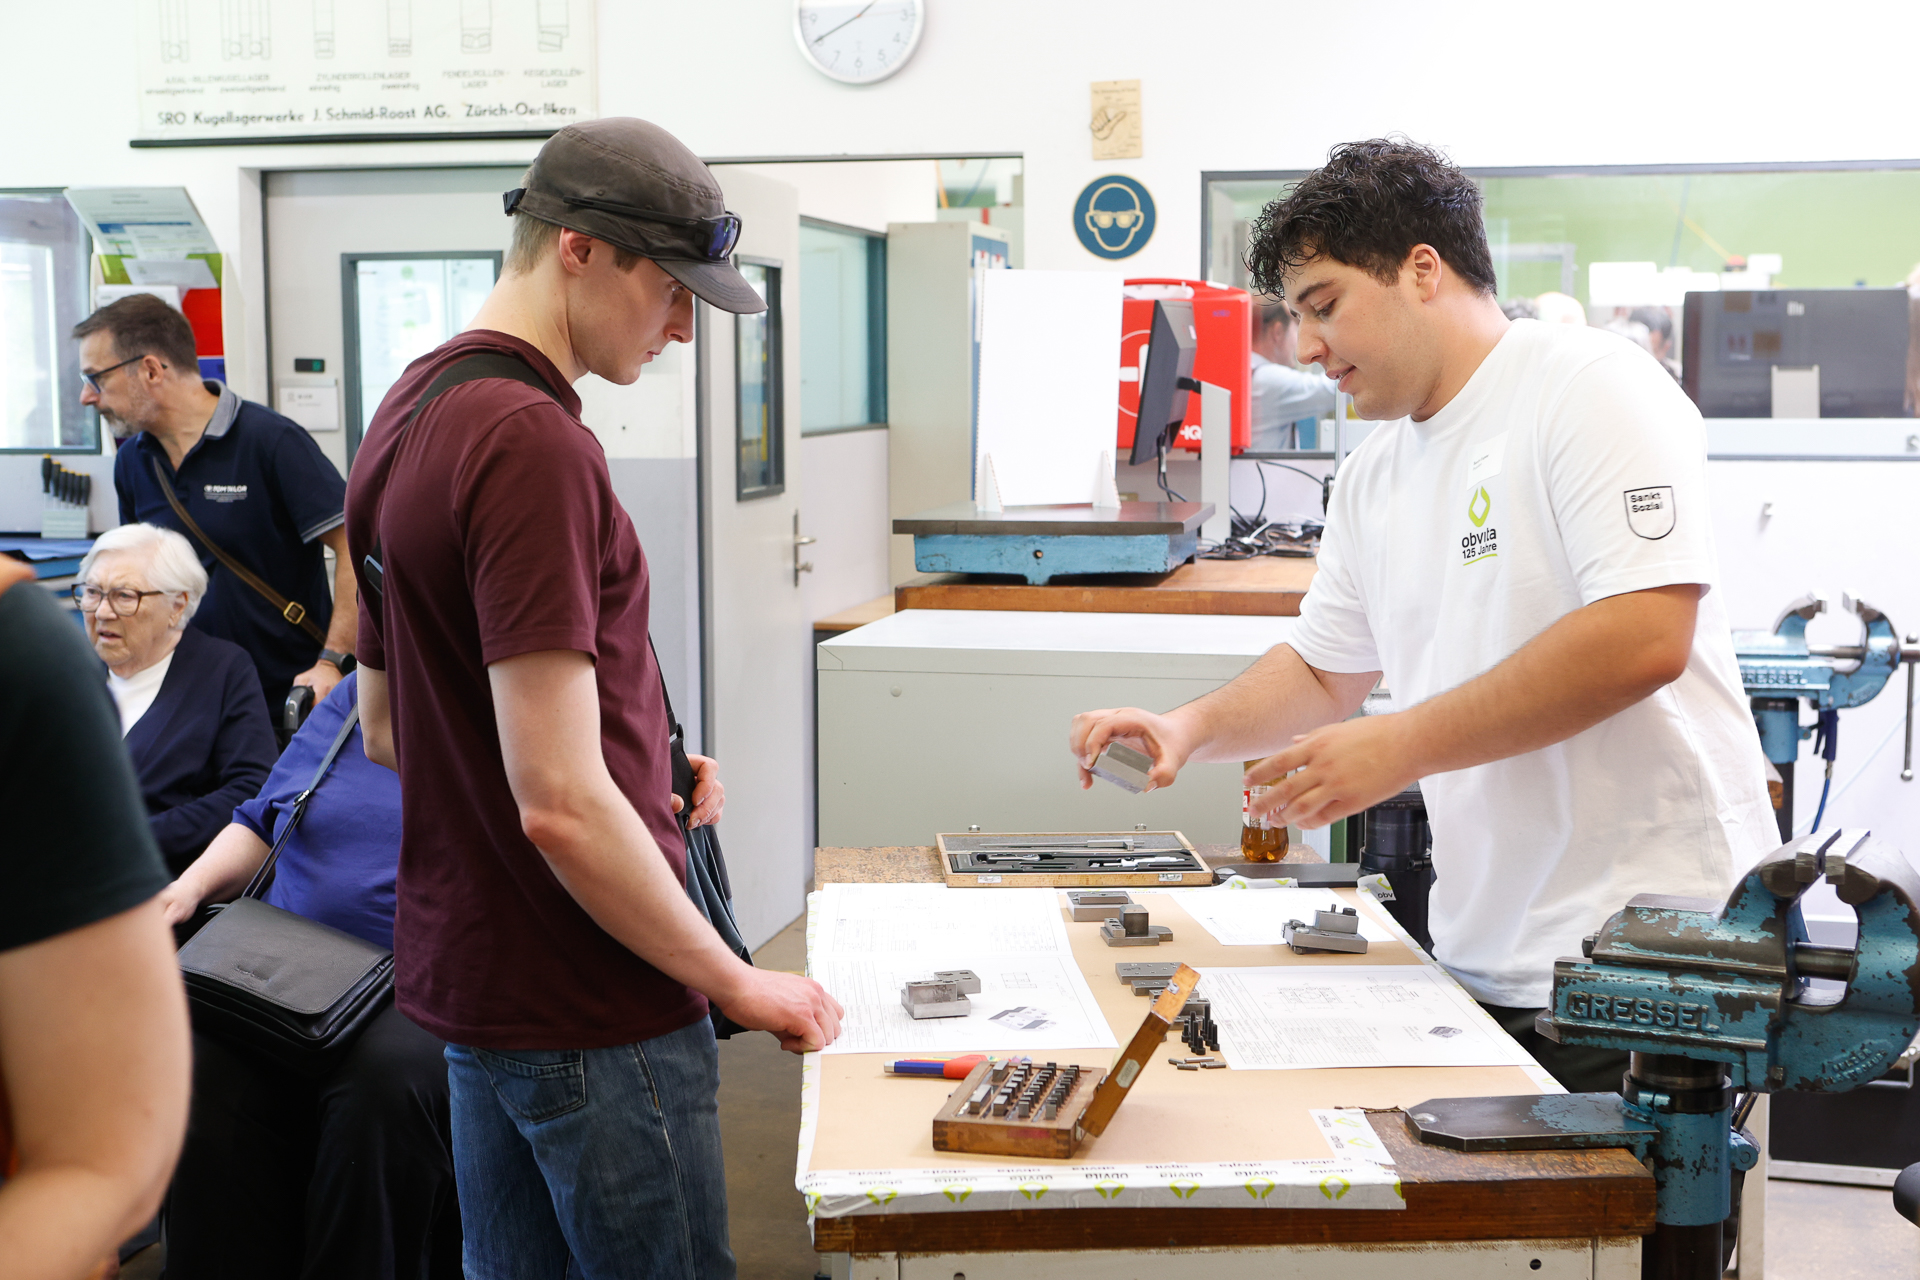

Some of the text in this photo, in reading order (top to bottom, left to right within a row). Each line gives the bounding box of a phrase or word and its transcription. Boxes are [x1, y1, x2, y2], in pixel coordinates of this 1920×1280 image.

[157, 111, 187, 125] SRO
[193, 108, 304, 127] Kugellagerwerke
[325, 105, 416, 121] Schmid-Roost
[423, 104, 451, 119] AG.
[1630, 492, 1661, 503] Sankt
[1632, 501, 1663, 513] Sozial
[1461, 527, 1497, 549] obvita
[1462, 542, 1497, 560] 125 Jahre
[1567, 990, 1720, 1034] GRESSEL
